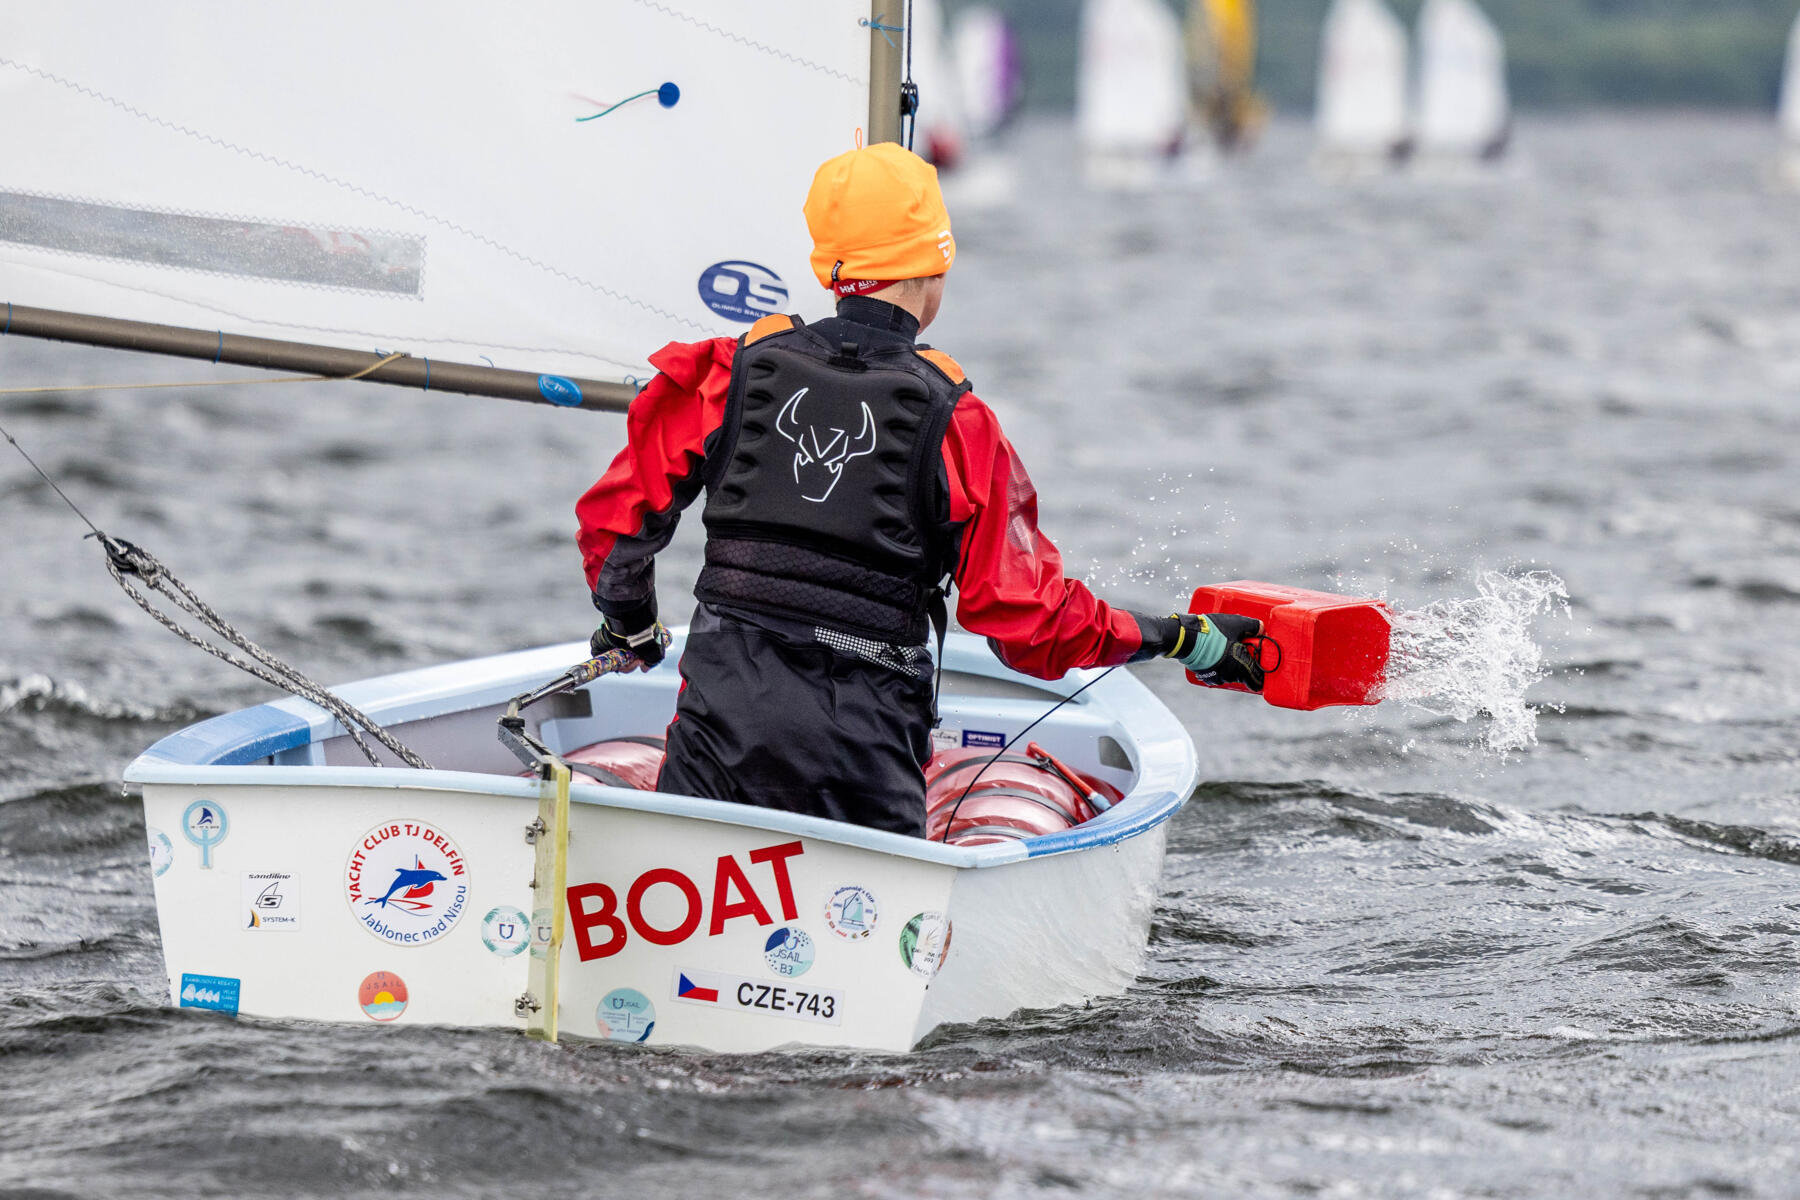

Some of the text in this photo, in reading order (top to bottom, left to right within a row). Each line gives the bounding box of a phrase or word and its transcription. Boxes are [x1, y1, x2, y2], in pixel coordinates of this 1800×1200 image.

[711, 302, 743, 314] OLIMPIC
[967, 733, 1002, 743] OPTIMIST
[348, 824, 465, 903] YACHT CLUB TJ DELFÍN
[248, 872, 291, 880] sandiline
[566, 840, 804, 962] BOAT
[360, 885, 467, 942] Jablonec nad Nisou
[773, 948, 804, 964] JSAIL
[779, 963, 794, 975] B3
[737, 982, 835, 1018] CZE-743
